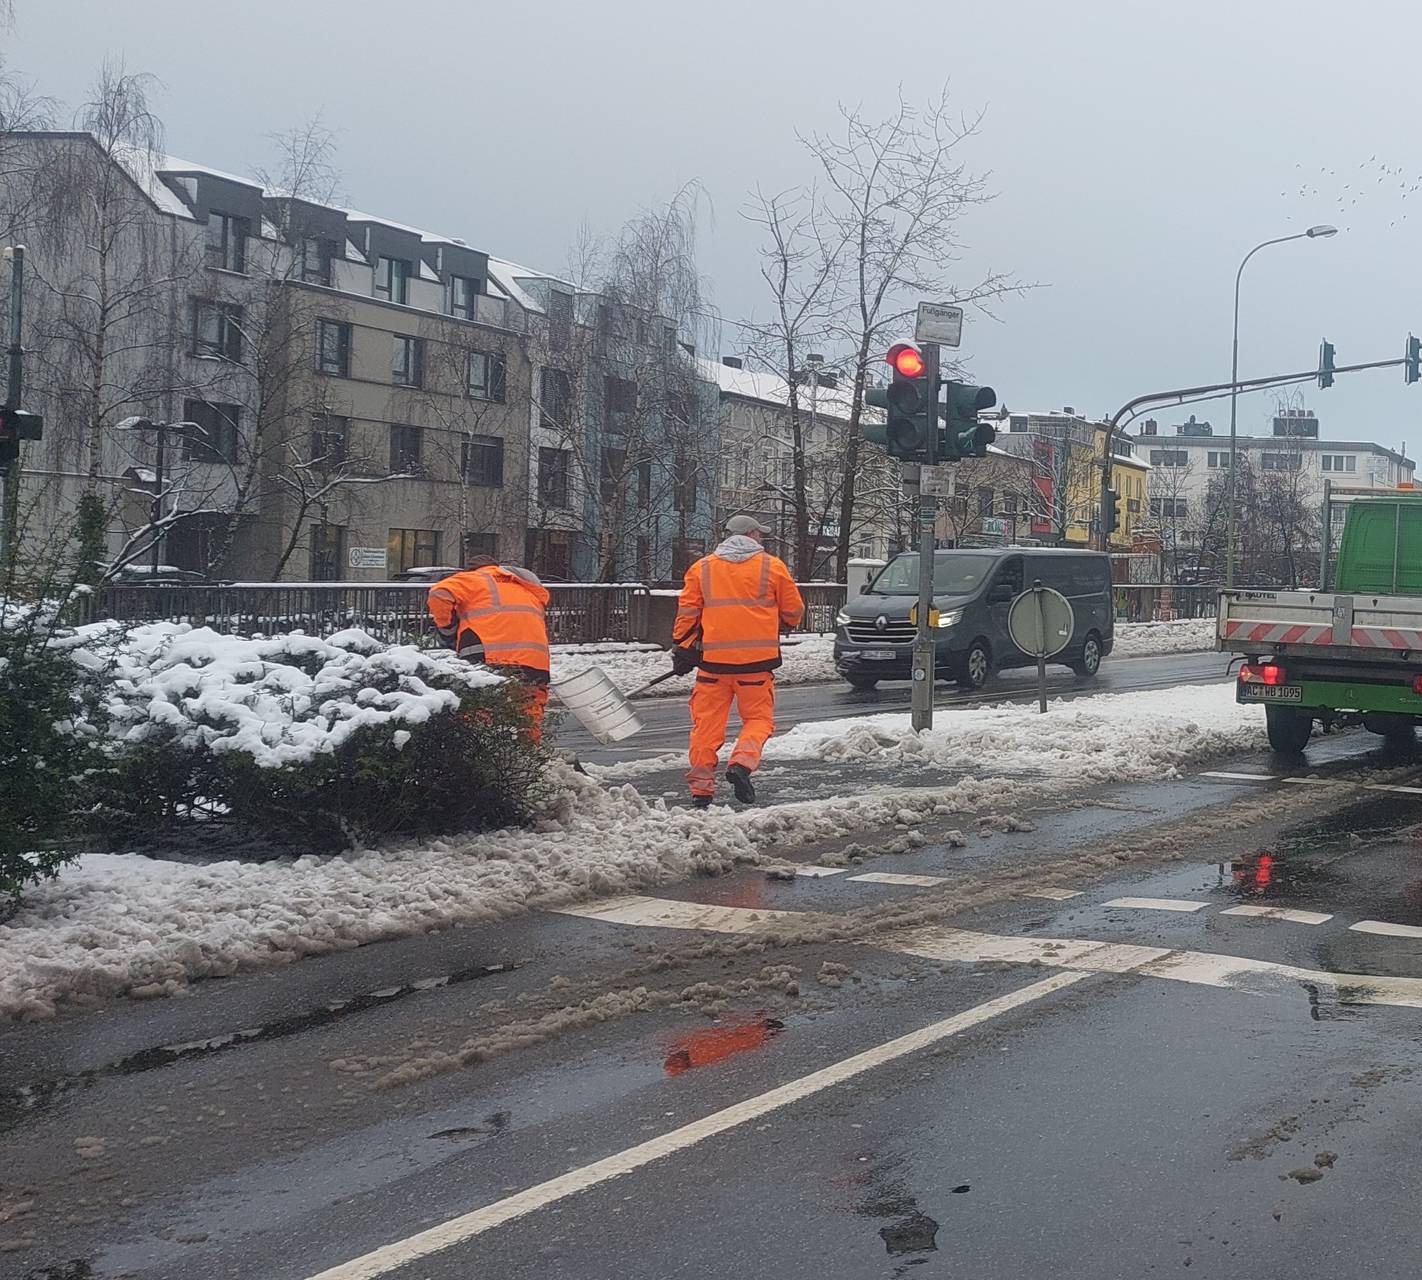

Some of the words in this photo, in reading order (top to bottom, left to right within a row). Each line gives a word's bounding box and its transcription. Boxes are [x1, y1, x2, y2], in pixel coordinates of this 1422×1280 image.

[1246, 685, 1258, 696] AC
[1264, 686, 1276, 697] WB
[1278, 687, 1300, 698] 1095
